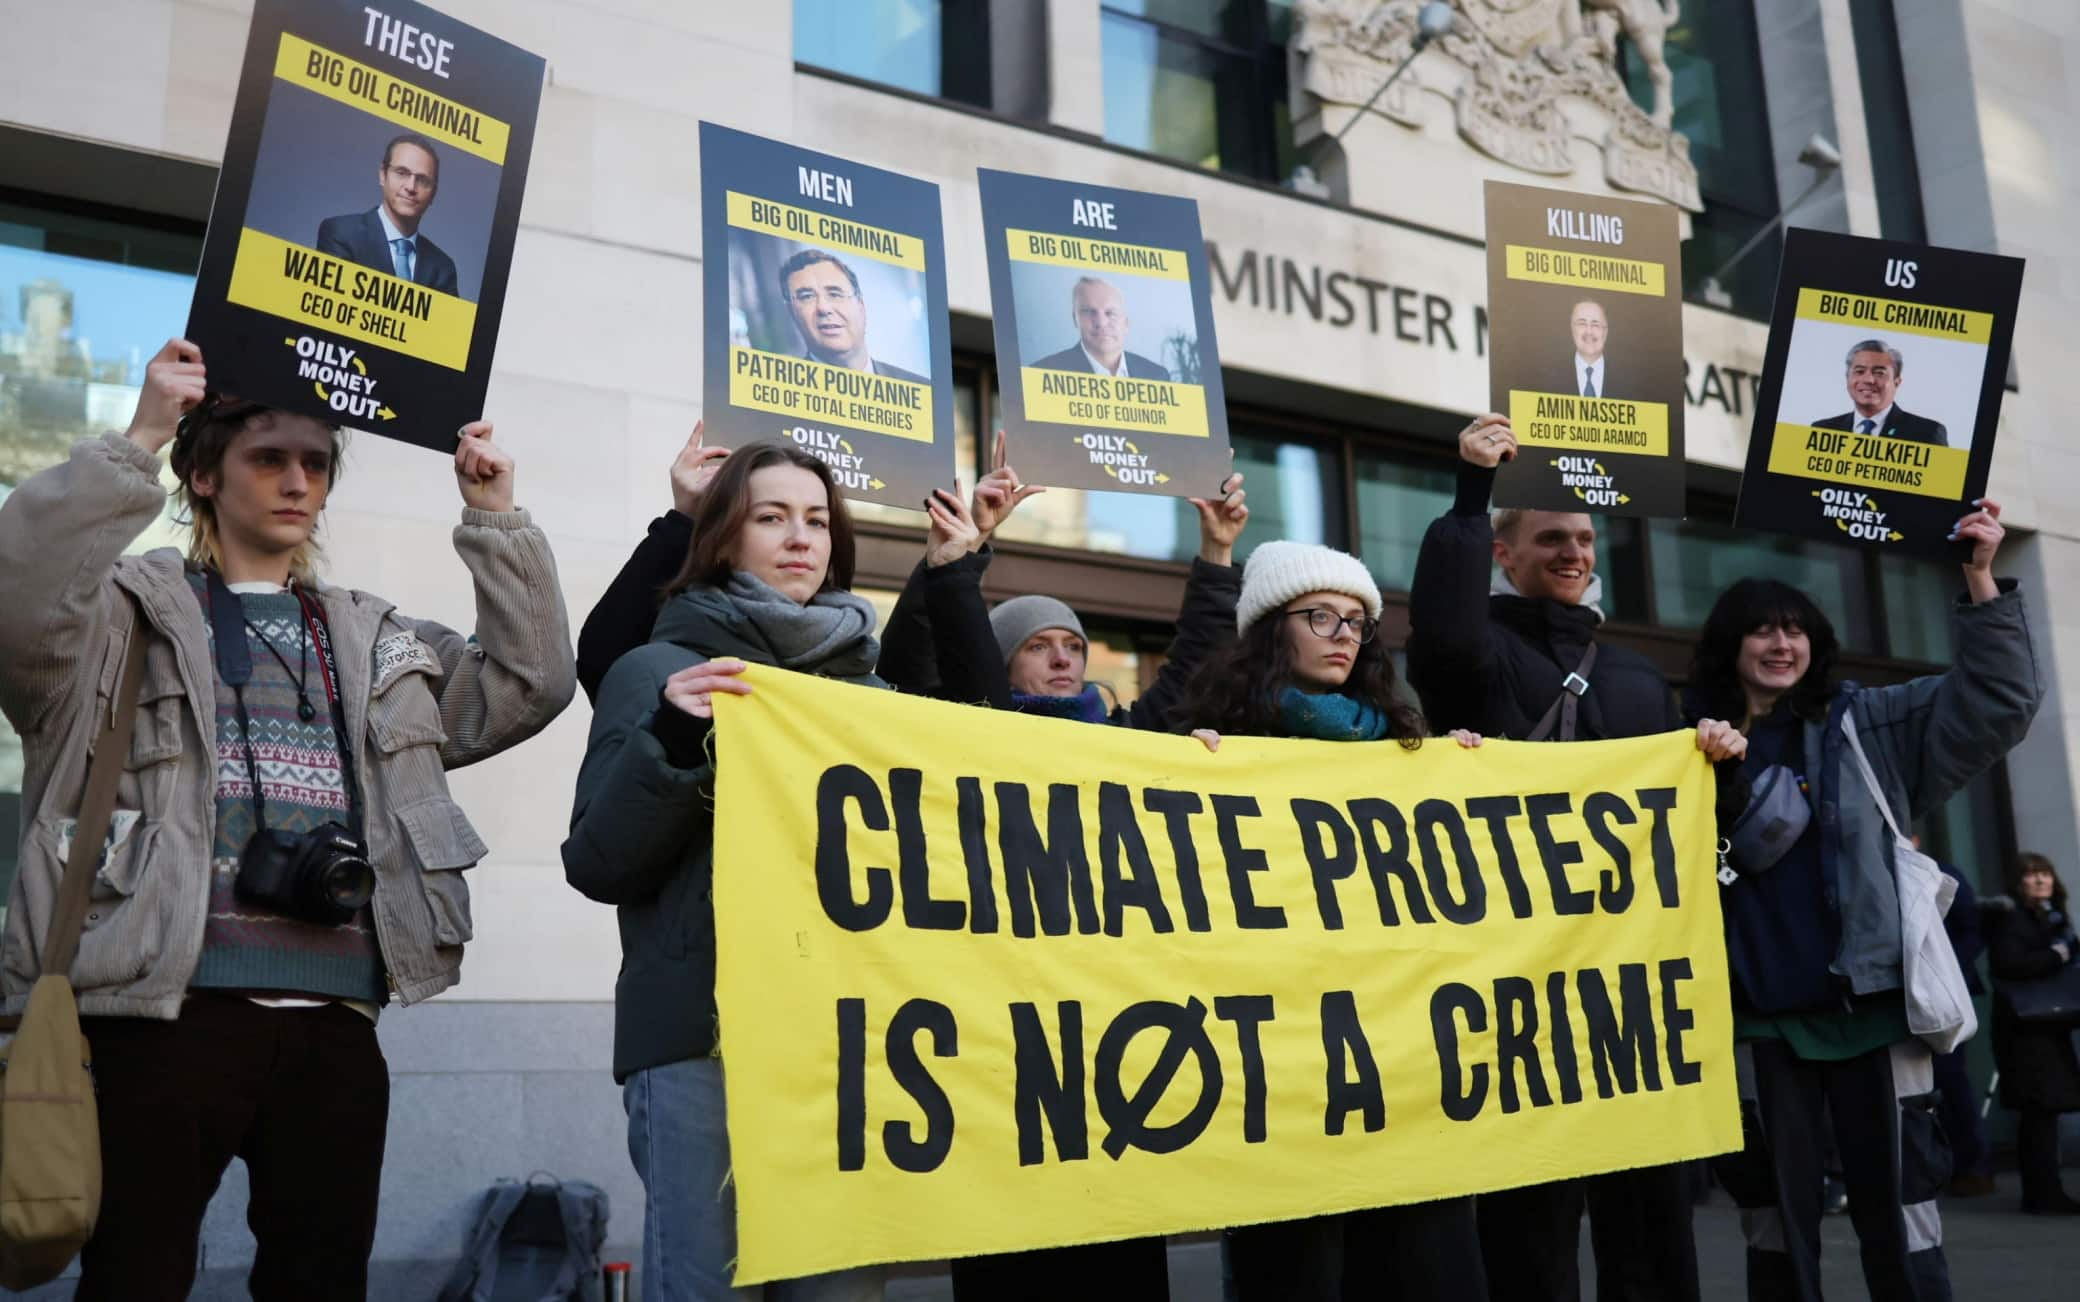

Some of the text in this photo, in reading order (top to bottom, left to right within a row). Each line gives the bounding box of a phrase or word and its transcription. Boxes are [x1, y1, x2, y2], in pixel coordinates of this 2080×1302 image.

[364, 6, 454, 79] THESE
[306, 49, 482, 144] BIG OIL CRIMINAL
[798, 166, 853, 207] MEN
[751, 201, 903, 258] BIG OIL CRIMINAL
[1073, 199, 1117, 230] ARE
[1547, 207, 1623, 245] KILLING
[1029, 235, 1168, 271] BIG OIL CRIMINAL
[1525, 251, 1647, 286] BIG OIL CRIMINAL
[284, 248, 432, 321] WAEL SAWAN
[1885, 258, 1918, 289] US
[301, 292, 407, 343] CEO OF SHELL
[1820, 294, 1968, 334] BIG OIL CRIMINAL
[296, 336, 356, 368] OILY
[299, 360, 377, 395] MONEY
[737, 351, 922, 410] PATRICK POUYANNE
[1042, 373, 1180, 407] ANDERS OPEDAL
[330, 391, 380, 419] OUT
[753, 384, 913, 430] CEO OF TOTAL ENERGIES
[1069, 401, 1167, 425] CEO OF EQUINOR
[1536, 397, 1636, 425] AMIN NASSER
[792, 427, 840, 450] OILY
[1083, 433, 1126, 452] OILY
[1530, 422, 1647, 447] CEO OF SAUDI ARAMCO
[1806, 430, 1931, 468] ADIF ZULKIFLI
[1090, 451, 1148, 468] MONEY
[1558, 456, 1596, 473] OILY
[1807, 456, 1923, 487] CEO OF PETRONAS
[831, 468, 871, 490] OUT
[1118, 468, 1156, 485] OUT
[1562, 473, 1614, 488] MONEY
[1585, 489, 1619, 506] OUT
[1820, 488, 1868, 508] OILY
[1823, 505, 1886, 525] MONEY
[1848, 523, 1890, 542] OUT
[814, 763, 1679, 939] CLIMATE PROTEST
[836, 997, 960, 1174] IS
[1321, 989, 1386, 1136] A
[1430, 957, 1702, 1122] CRIME
